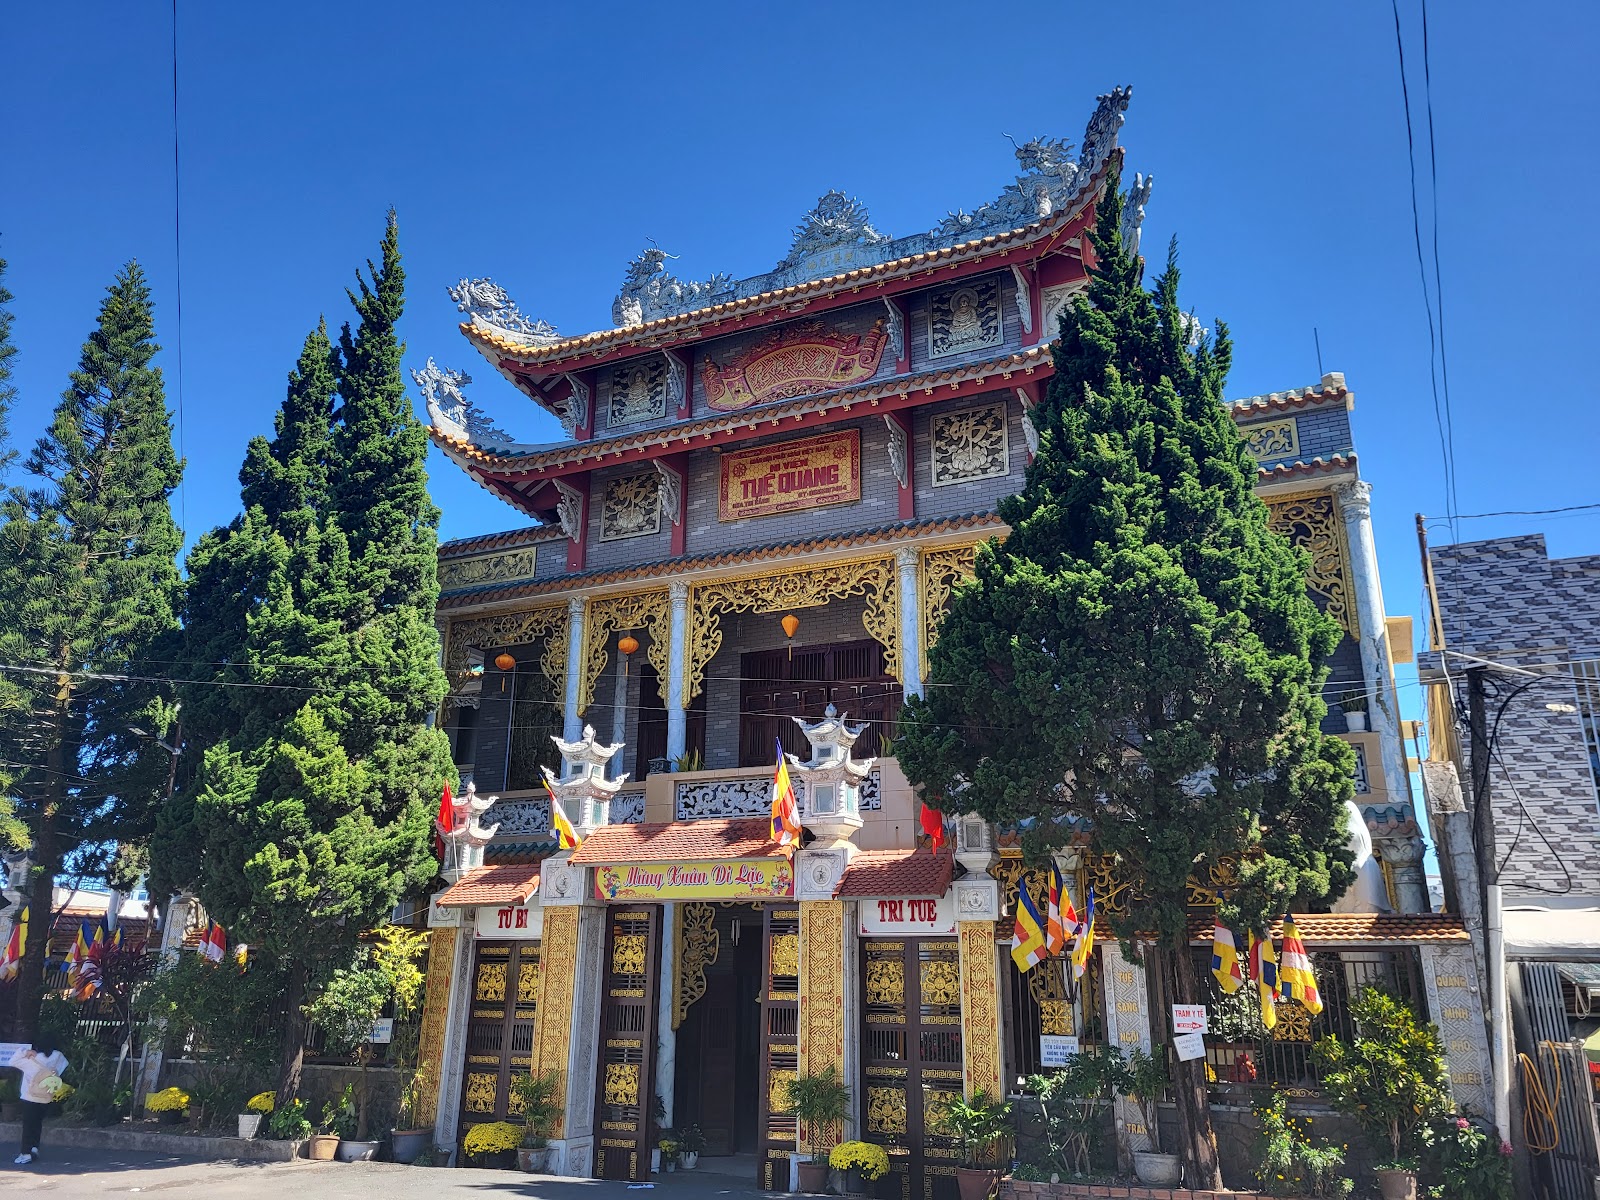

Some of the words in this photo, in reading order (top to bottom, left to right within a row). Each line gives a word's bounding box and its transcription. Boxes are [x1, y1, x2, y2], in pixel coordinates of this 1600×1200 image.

[778, 465, 839, 494] QUANG
[623, 866, 664, 891] Mừng
[667, 865, 709, 887] Xuân
[515, 909, 528, 928] BI
[1436, 976, 1467, 987] QUANG
[1444, 1008, 1468, 1019] MINH
